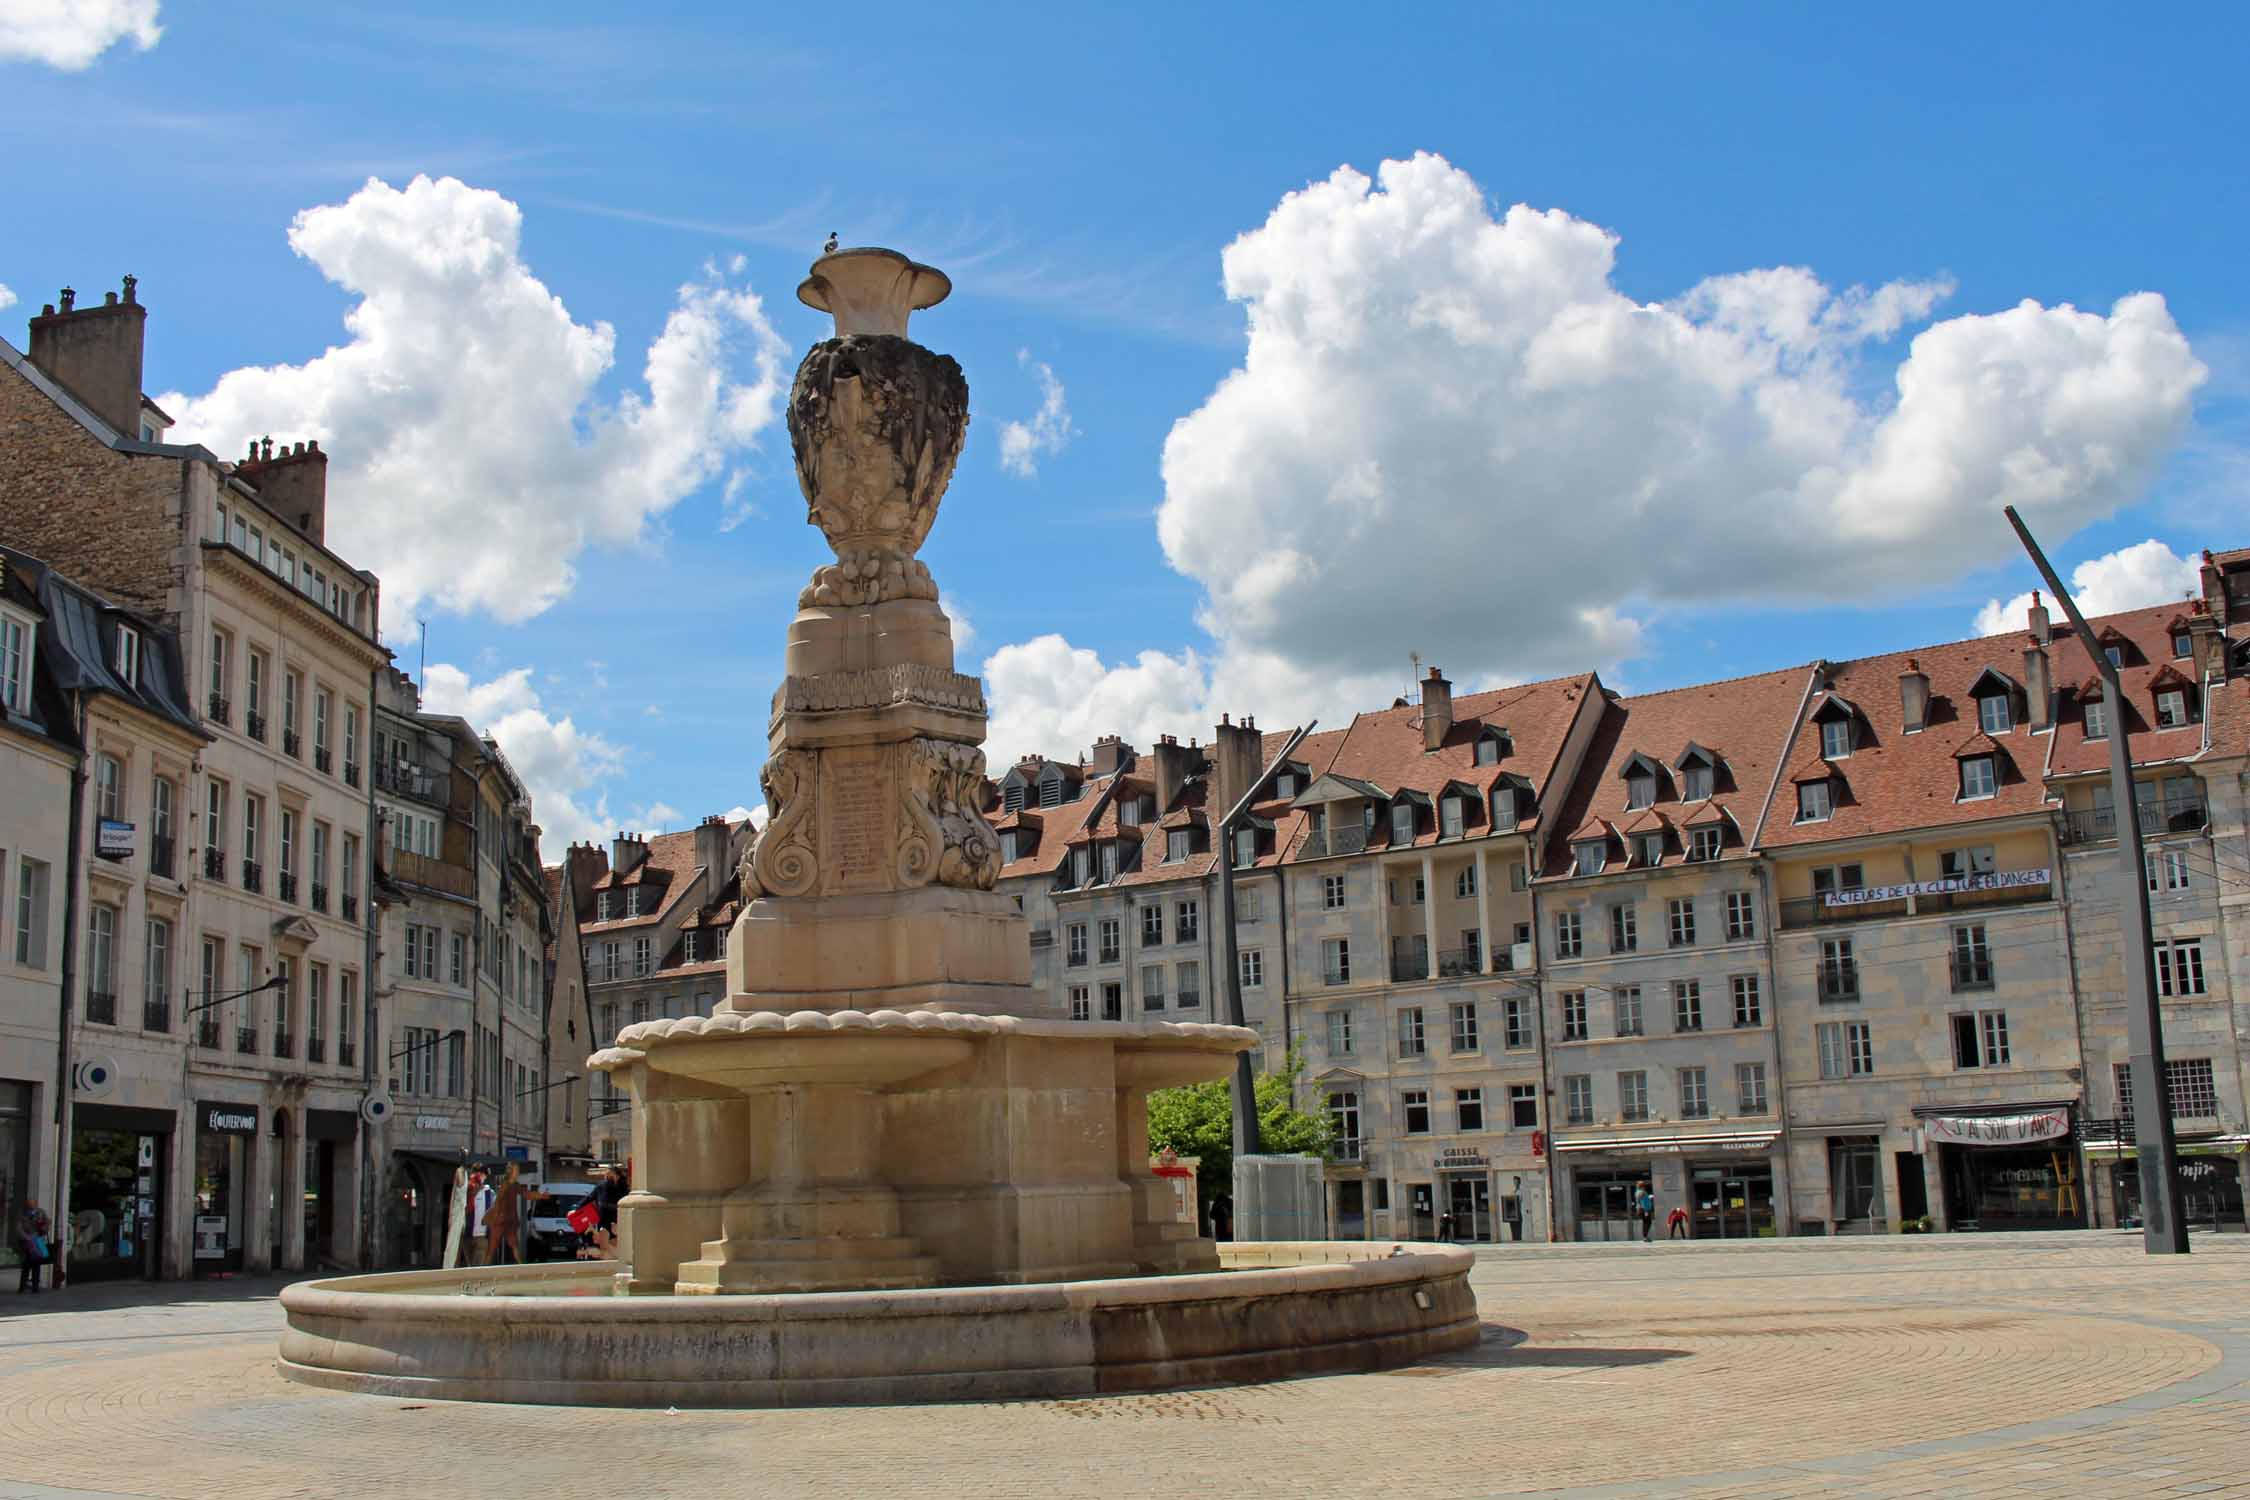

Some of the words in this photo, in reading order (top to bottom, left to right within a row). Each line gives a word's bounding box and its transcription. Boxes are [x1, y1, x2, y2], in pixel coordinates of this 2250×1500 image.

[1830, 887, 1884, 905] ACTEURS
[1888, 885, 1904, 898] DE
[1906, 883, 1920, 896] LA
[1927, 874, 1984, 893] CULTURE
[1985, 874, 1999, 888] EN
[2001, 869, 2046, 887] DANGER
[1989, 1117, 2009, 1141] SOIF
[1444, 1147, 1479, 1157] CAISSE
